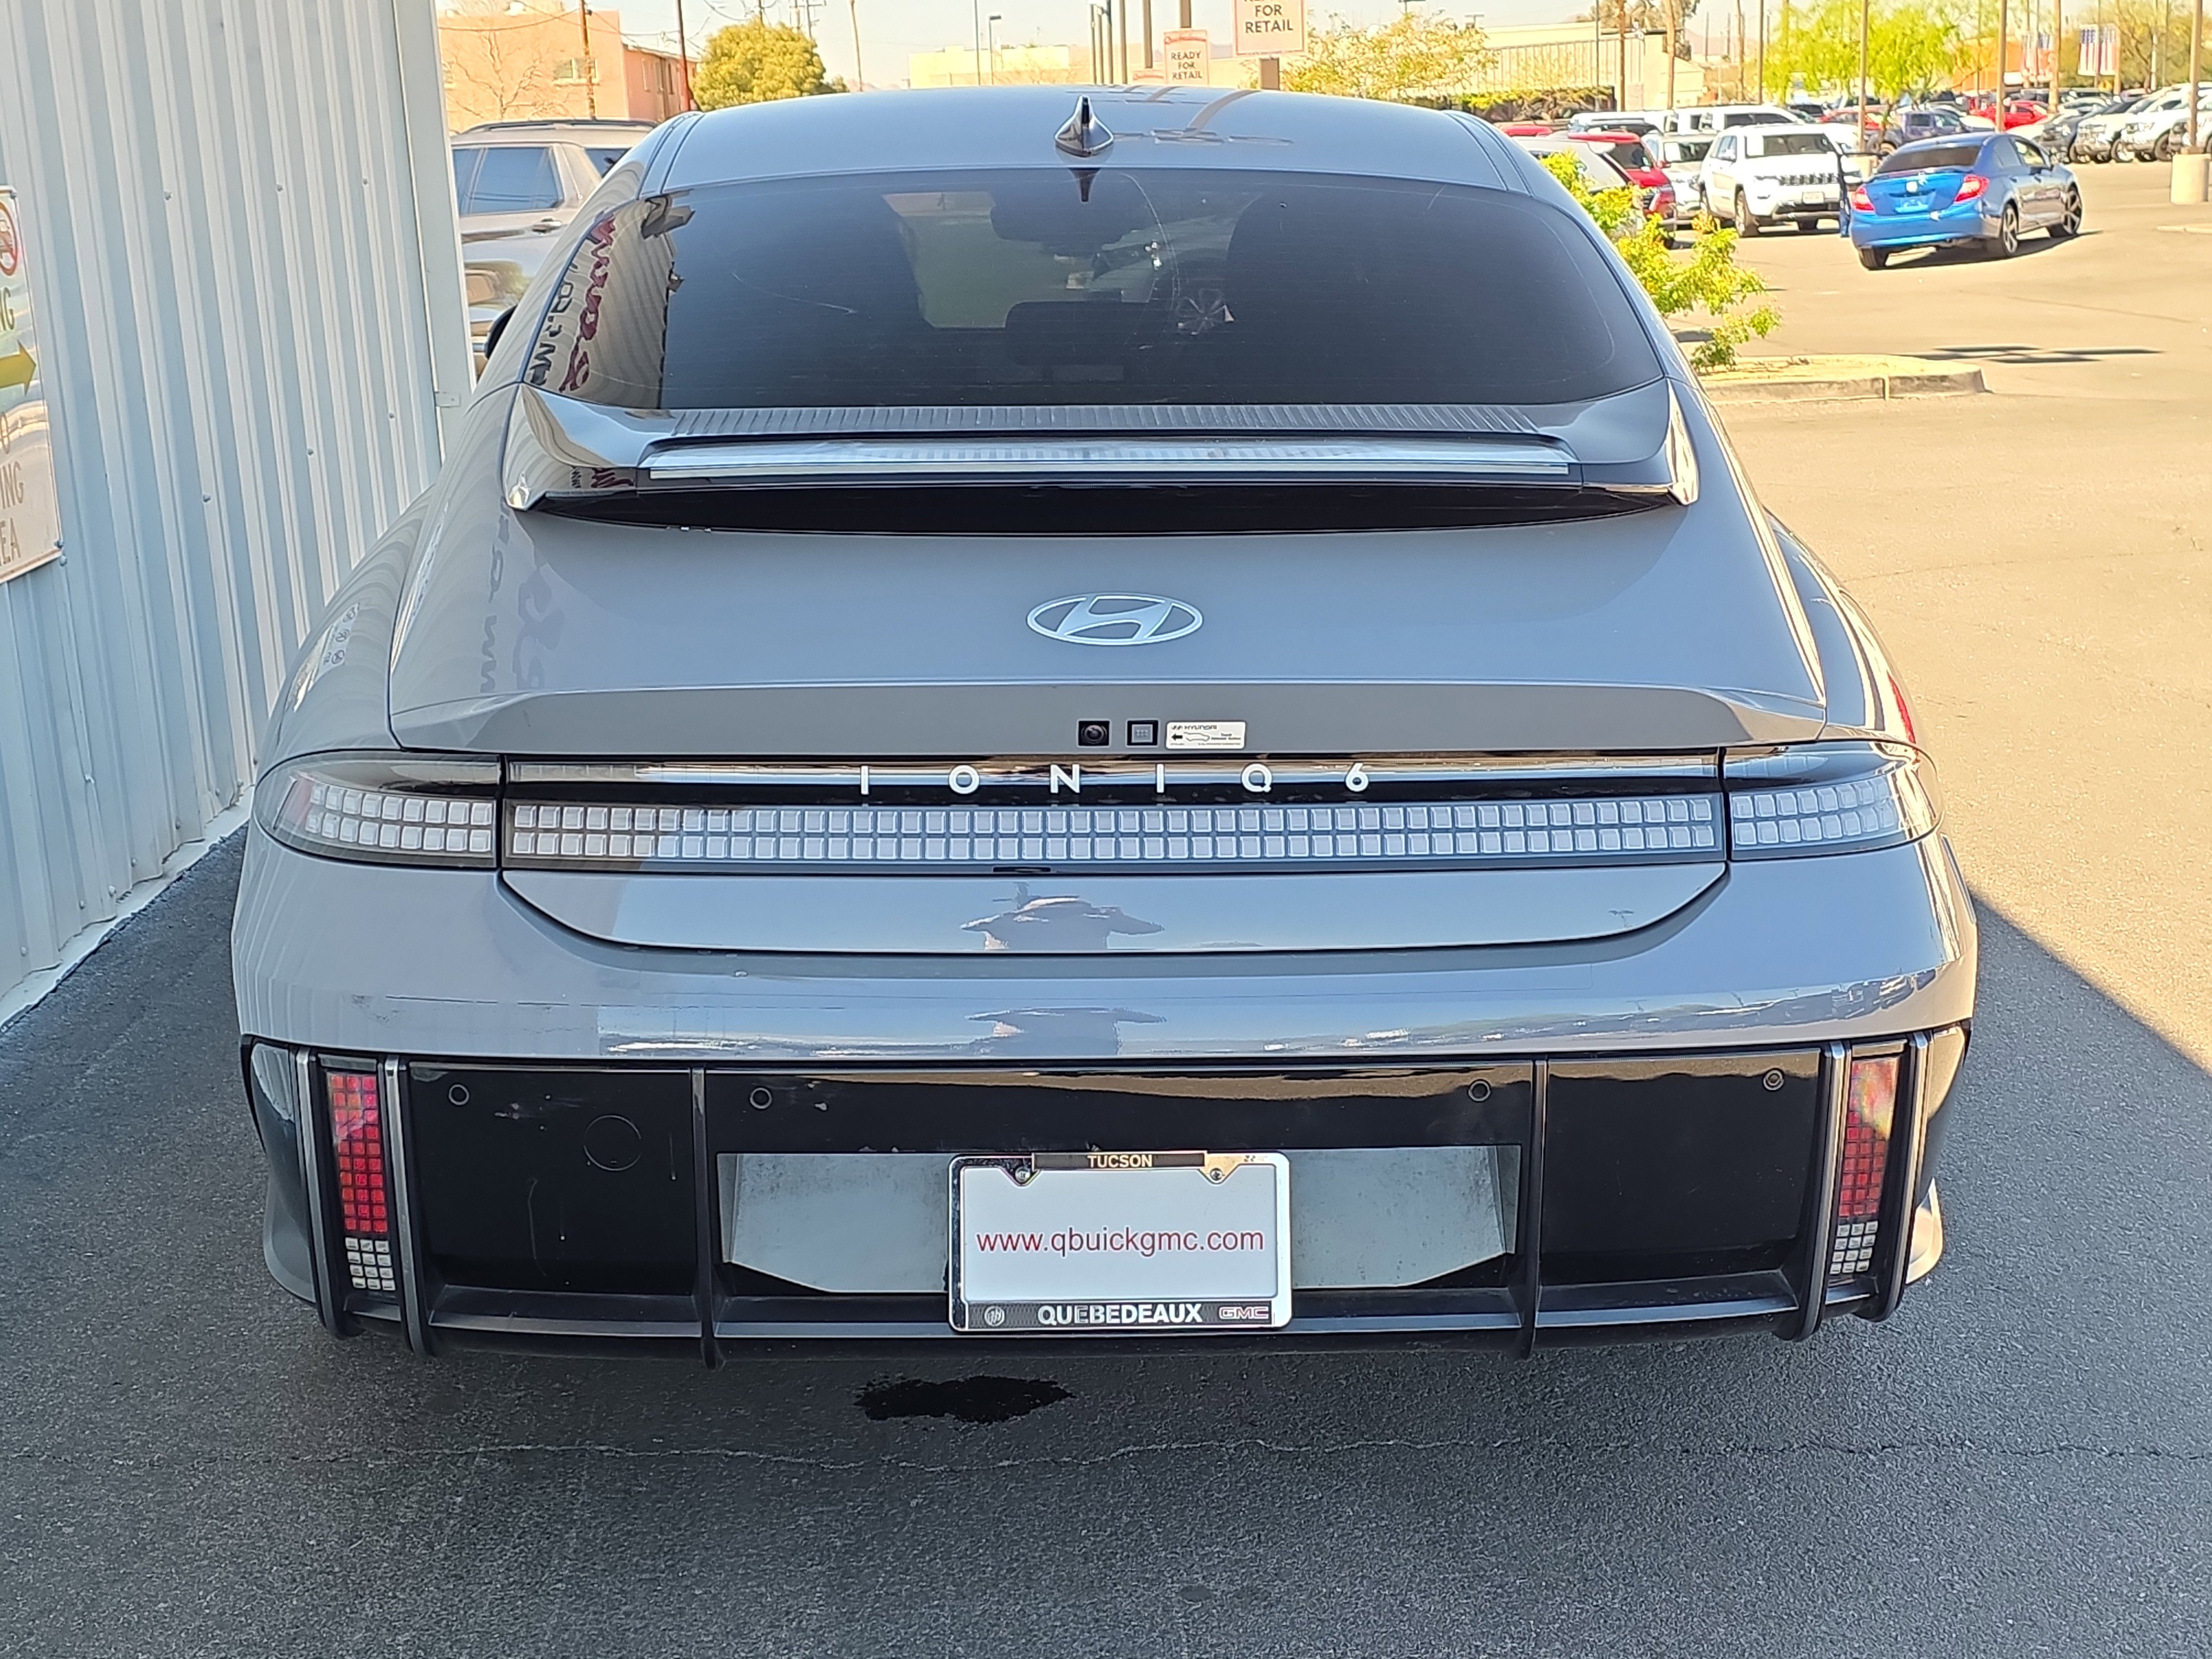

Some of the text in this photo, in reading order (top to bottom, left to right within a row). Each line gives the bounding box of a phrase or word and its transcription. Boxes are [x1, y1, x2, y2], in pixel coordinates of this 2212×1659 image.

[1255, 4, 1283, 17] FOR
[1245, 18, 1294, 34] RETAIL
[1171, 51, 1201, 60] READY
[1172, 71, 1203, 80] RETAIL
[1345, 762, 1370, 793] 6
[1086, 1154, 1153, 1168] TUCSON
[976, 1227, 1264, 1257] www.qbuickgmc.com
[1037, 1303, 1269, 1326] QUEBEDEAUX GMC
